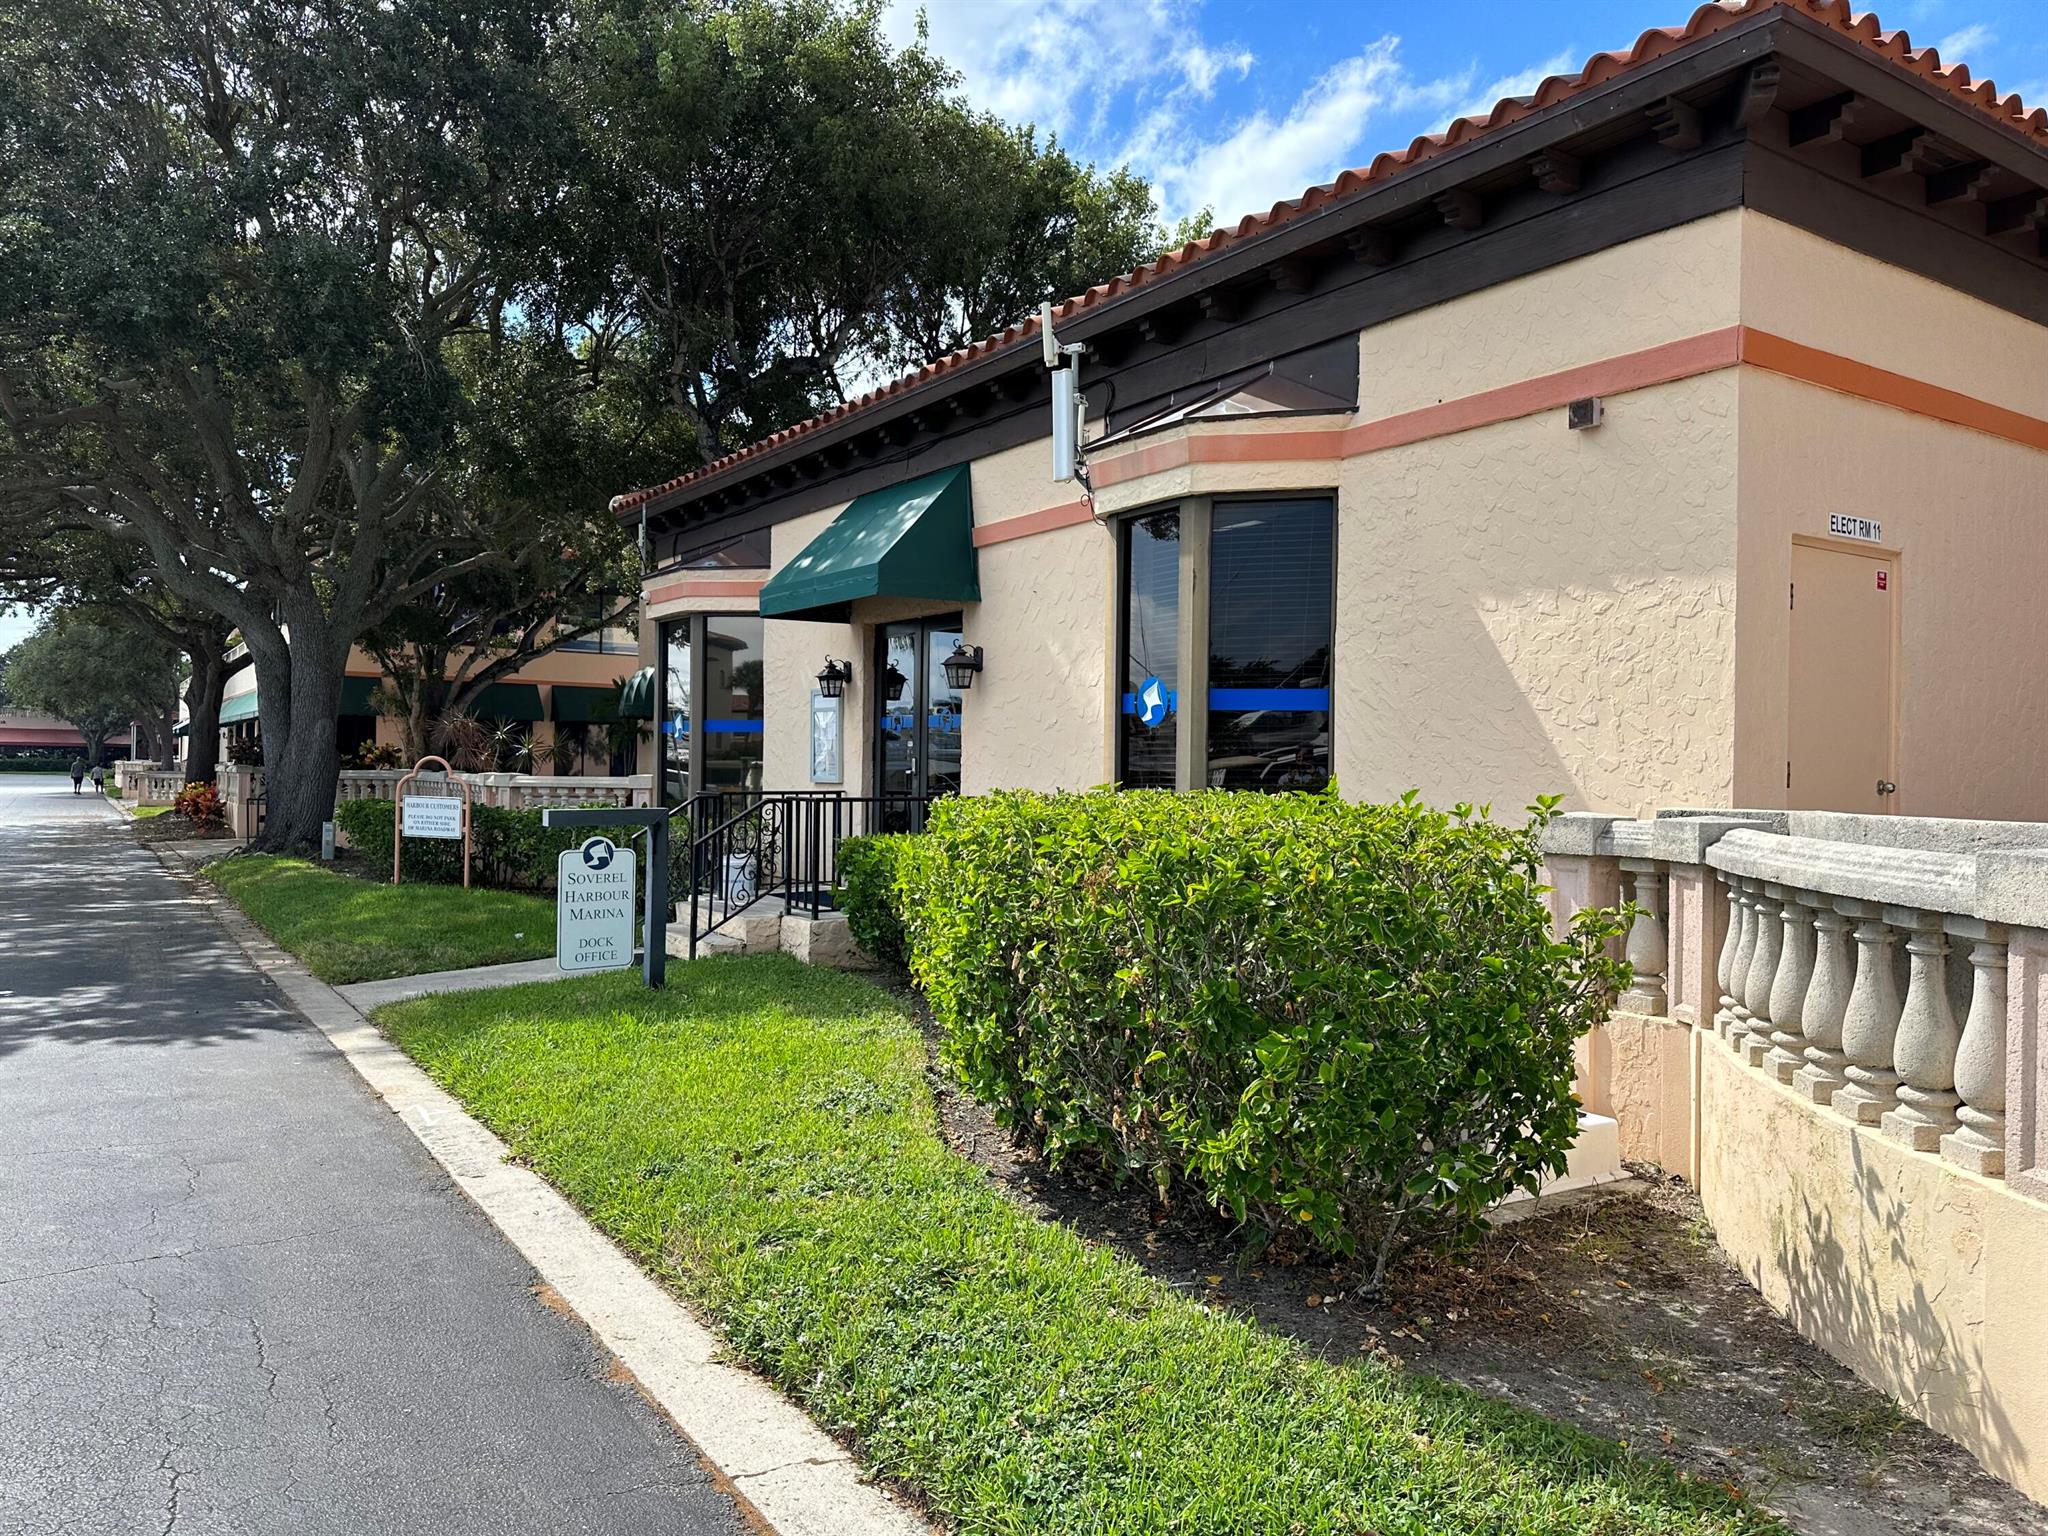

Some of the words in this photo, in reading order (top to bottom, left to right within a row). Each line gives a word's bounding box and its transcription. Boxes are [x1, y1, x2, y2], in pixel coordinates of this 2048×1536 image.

[1831, 515, 1857, 536] ELECT
[1859, 520, 1871, 538] RM
[1873, 523, 1881, 540] 11
[568, 873, 627, 885] SOVEREL
[565, 890, 630, 903] HARBOUR
[570, 909, 624, 921] MARINA
[579, 937, 613, 949] DOCK
[575, 950, 617, 962] OFFICE
